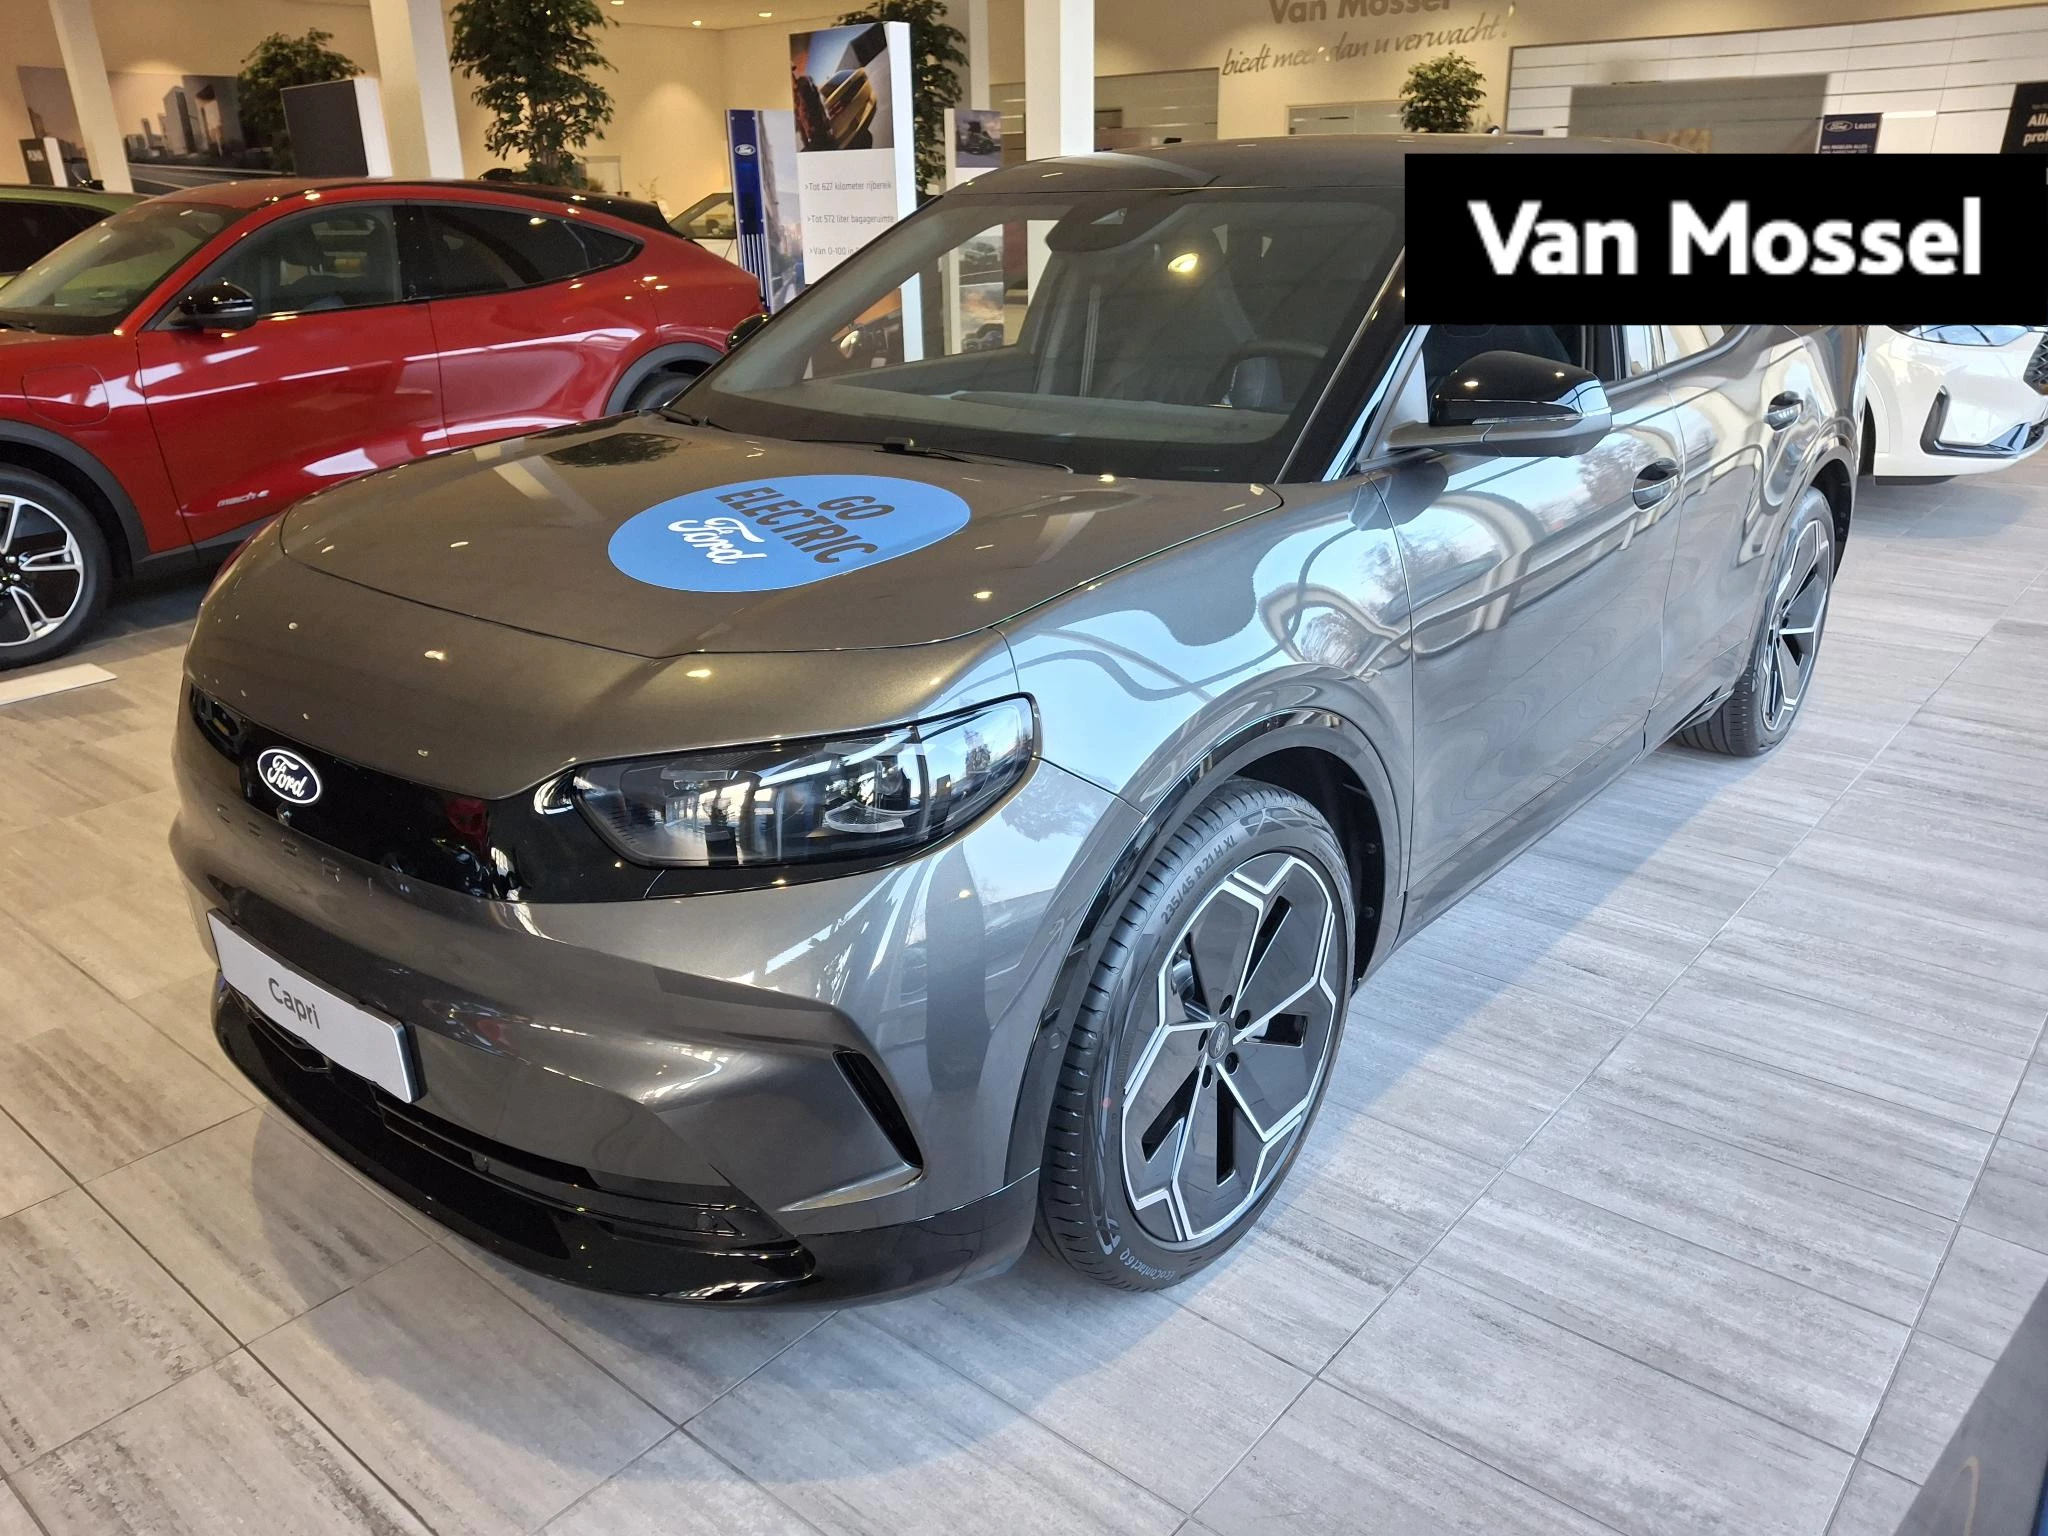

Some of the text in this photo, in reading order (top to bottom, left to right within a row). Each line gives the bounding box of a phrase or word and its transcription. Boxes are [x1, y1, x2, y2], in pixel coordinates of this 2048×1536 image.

[1269, 0, 1327, 24] Van
[1222, 43, 1271, 76] biedt
[715, 487, 878, 563] ELECTRIC
[817, 495, 895, 520] GO
[668, 517, 767, 564] Ford
[266, 754, 308, 798] Ford
[1161, 835, 1238, 925] 235/45 R 21 H XL
[268, 977, 320, 1030] Capri
